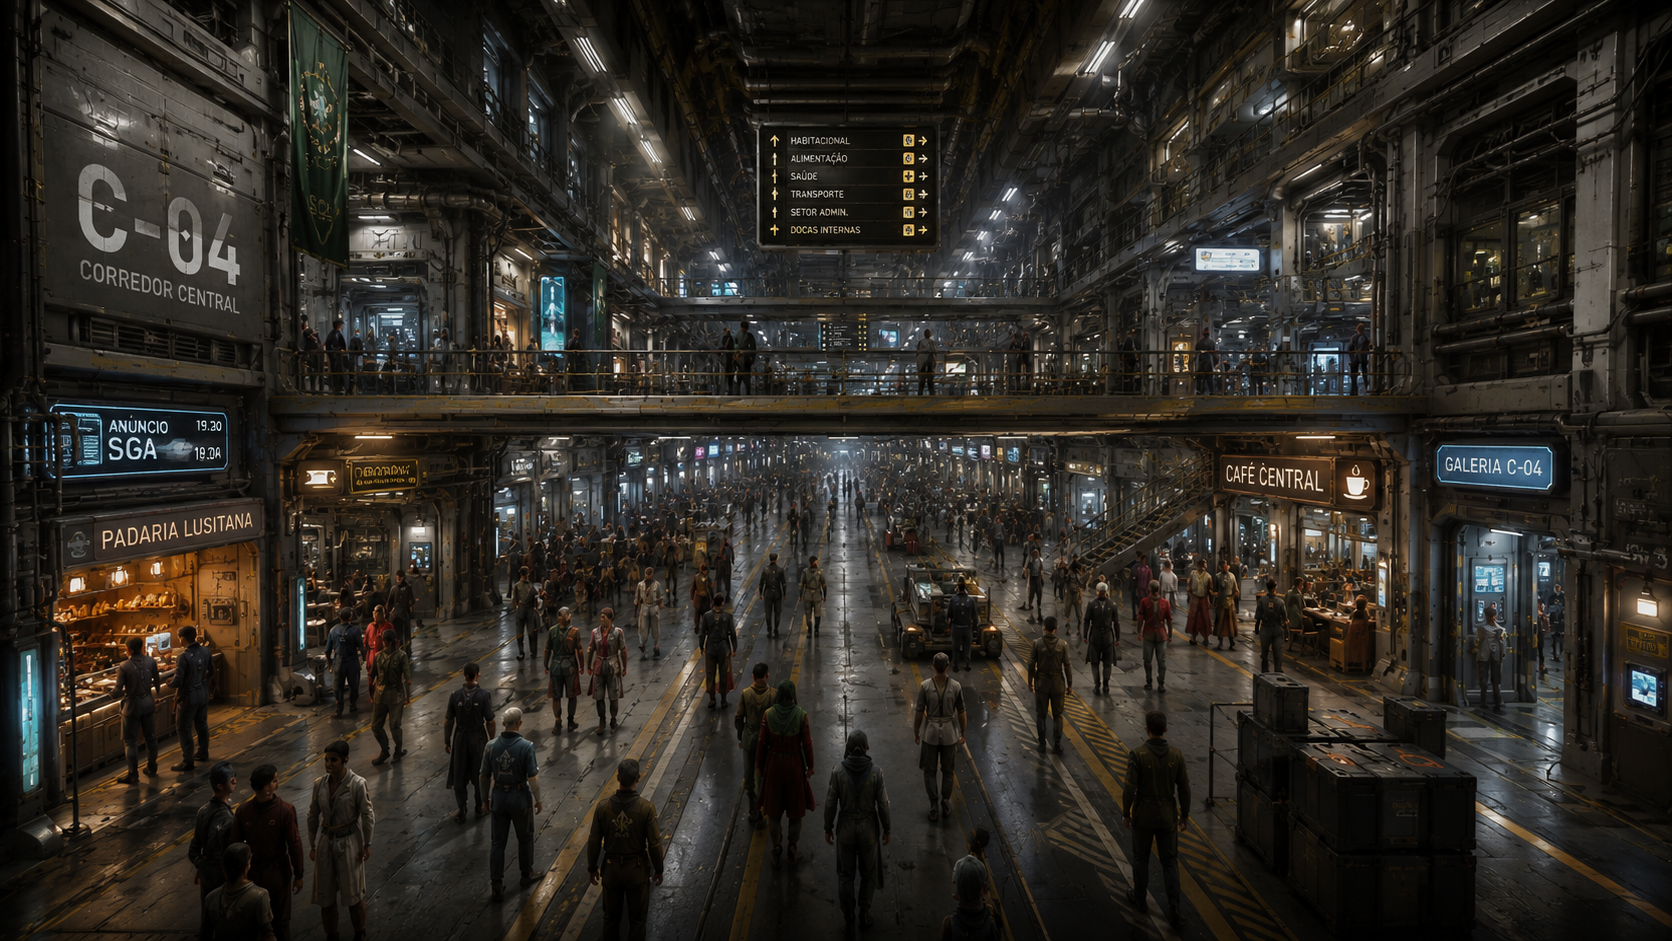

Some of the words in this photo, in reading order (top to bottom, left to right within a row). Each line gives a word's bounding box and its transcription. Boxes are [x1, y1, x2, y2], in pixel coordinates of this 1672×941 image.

[790, 136, 850, 146] HABITACIONAL
[790, 189, 844, 199] TRANSPORTE
[790, 208, 817, 217] SETOR
[819, 208, 848, 217] ADMIN.
[78, 163, 241, 286] C-04
[790, 225, 818, 235] DOCAS
[820, 225, 861, 235] INTERNAS
[80, 259, 173, 299] CORREDOR
[178, 284, 240, 314] CENTRAL
[108, 414, 169, 434] ANÚNCIO
[108, 436, 157, 461] SGA
[1226, 462, 1256, 485] CAFÉ
[1445, 456, 1502, 475] GALERIA
[1507, 459, 1543, 477] C-04
[102, 521, 179, 550] PADARIA
[184, 512, 253, 538] LUSITANA
